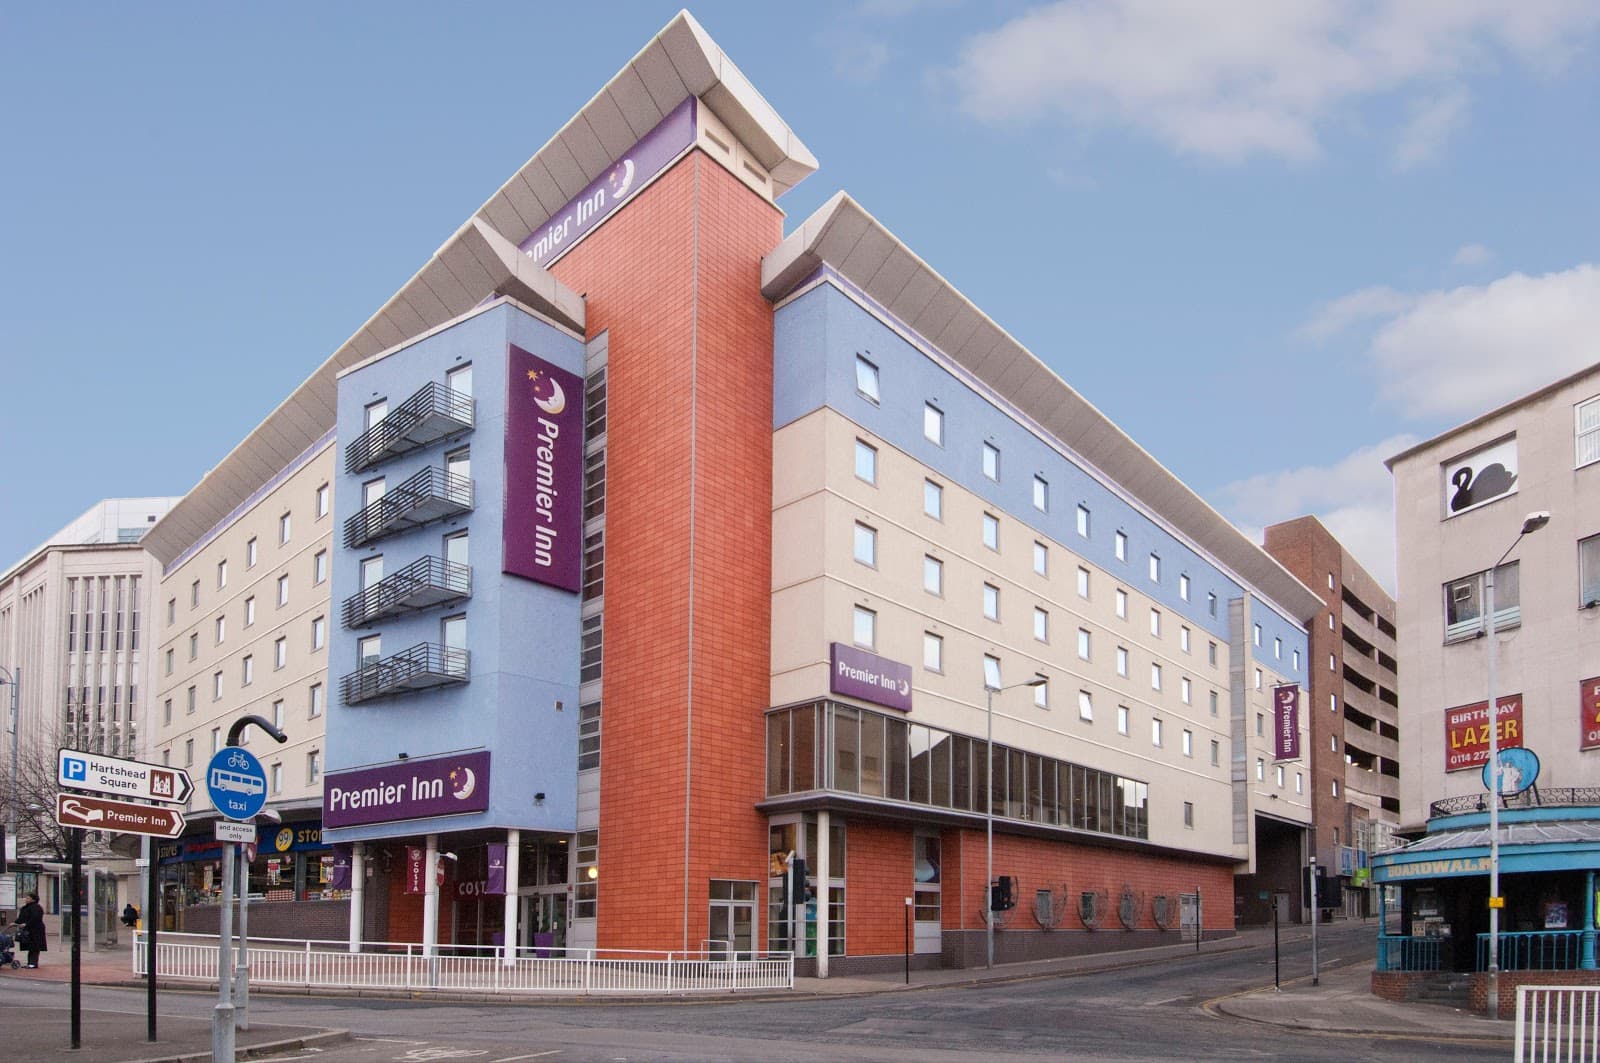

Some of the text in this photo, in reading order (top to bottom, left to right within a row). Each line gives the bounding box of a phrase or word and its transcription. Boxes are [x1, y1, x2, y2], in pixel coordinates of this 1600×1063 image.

[526, 188, 605, 263] mier Inn
[534, 417, 559, 567] Premier Inn
[839, 661, 896, 691] Premier Inn
[1283, 705, 1293, 753] Premier Inn
[1451, 719, 1518, 749] LAZER
[1450, 753, 1471, 764] 0114
[90, 761, 146, 780] Hartshead
[100, 775, 138, 790] Square
[330, 776, 443, 812] Premier Inn
[228, 799, 247, 811] taxi
[107, 810, 167, 827] Premier Inn
[229, 832, 242, 840] only
[232, 825, 253, 833] access
[297, 829, 322, 843] STO
[459, 880, 486, 896] COST
